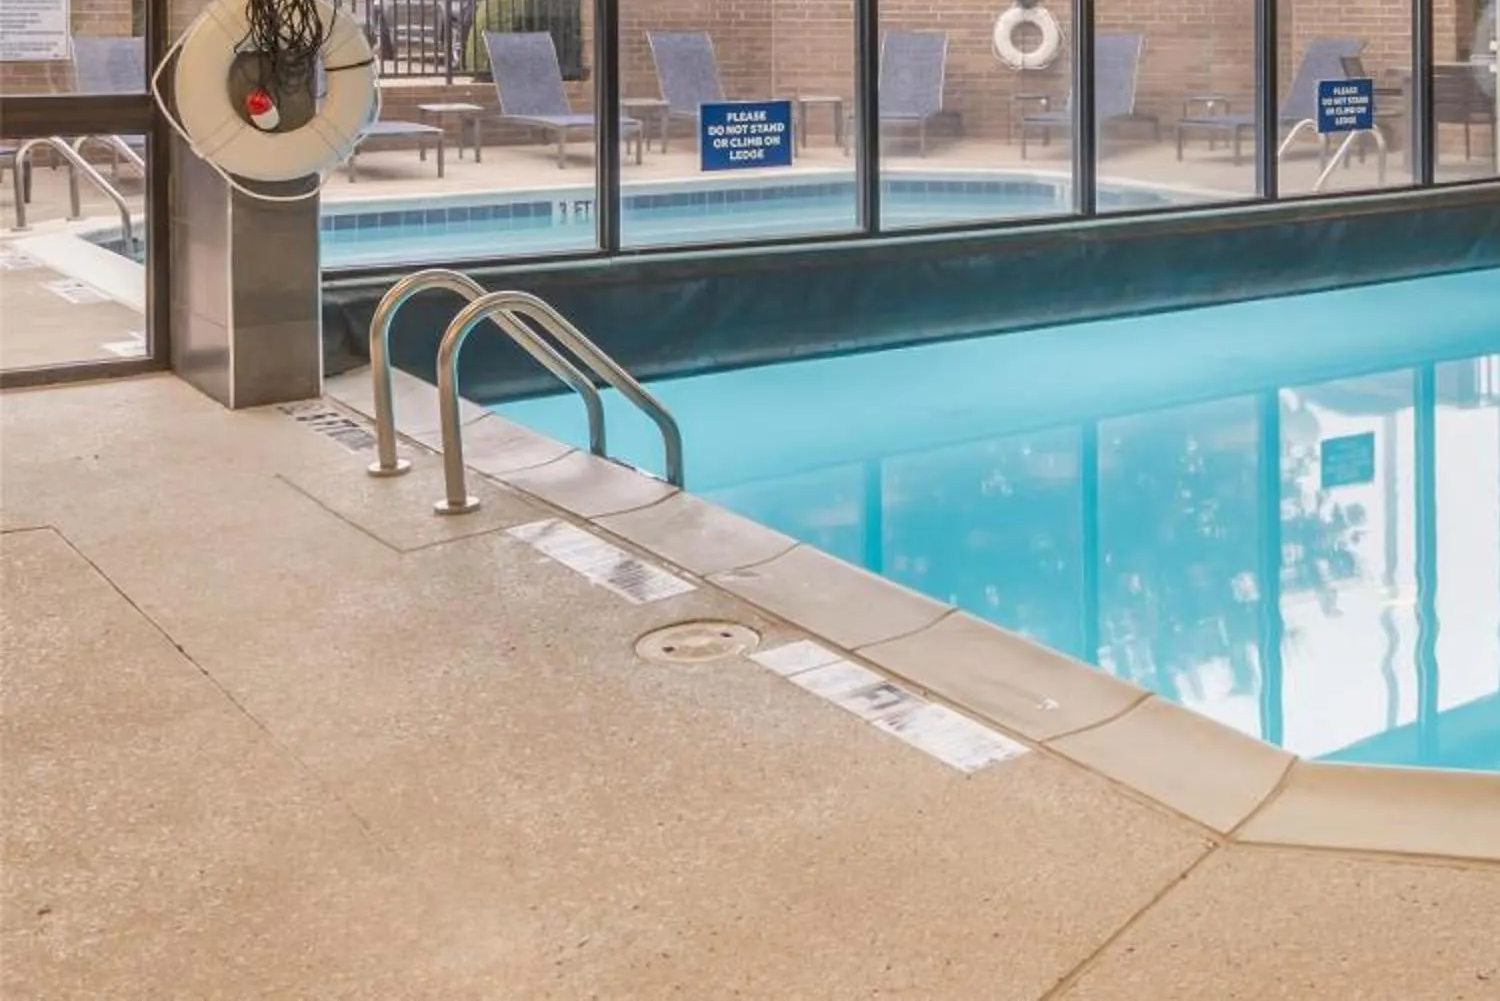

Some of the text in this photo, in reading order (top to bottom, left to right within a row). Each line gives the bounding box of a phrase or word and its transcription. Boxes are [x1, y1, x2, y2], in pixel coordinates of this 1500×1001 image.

[726, 111, 767, 122] PLEASE
[707, 122, 785, 136] DO NOT STAND
[713, 136, 781, 149] OR CLIMB ON
[729, 149, 765, 160] LEDGE
[574, 200, 592, 214] FT
